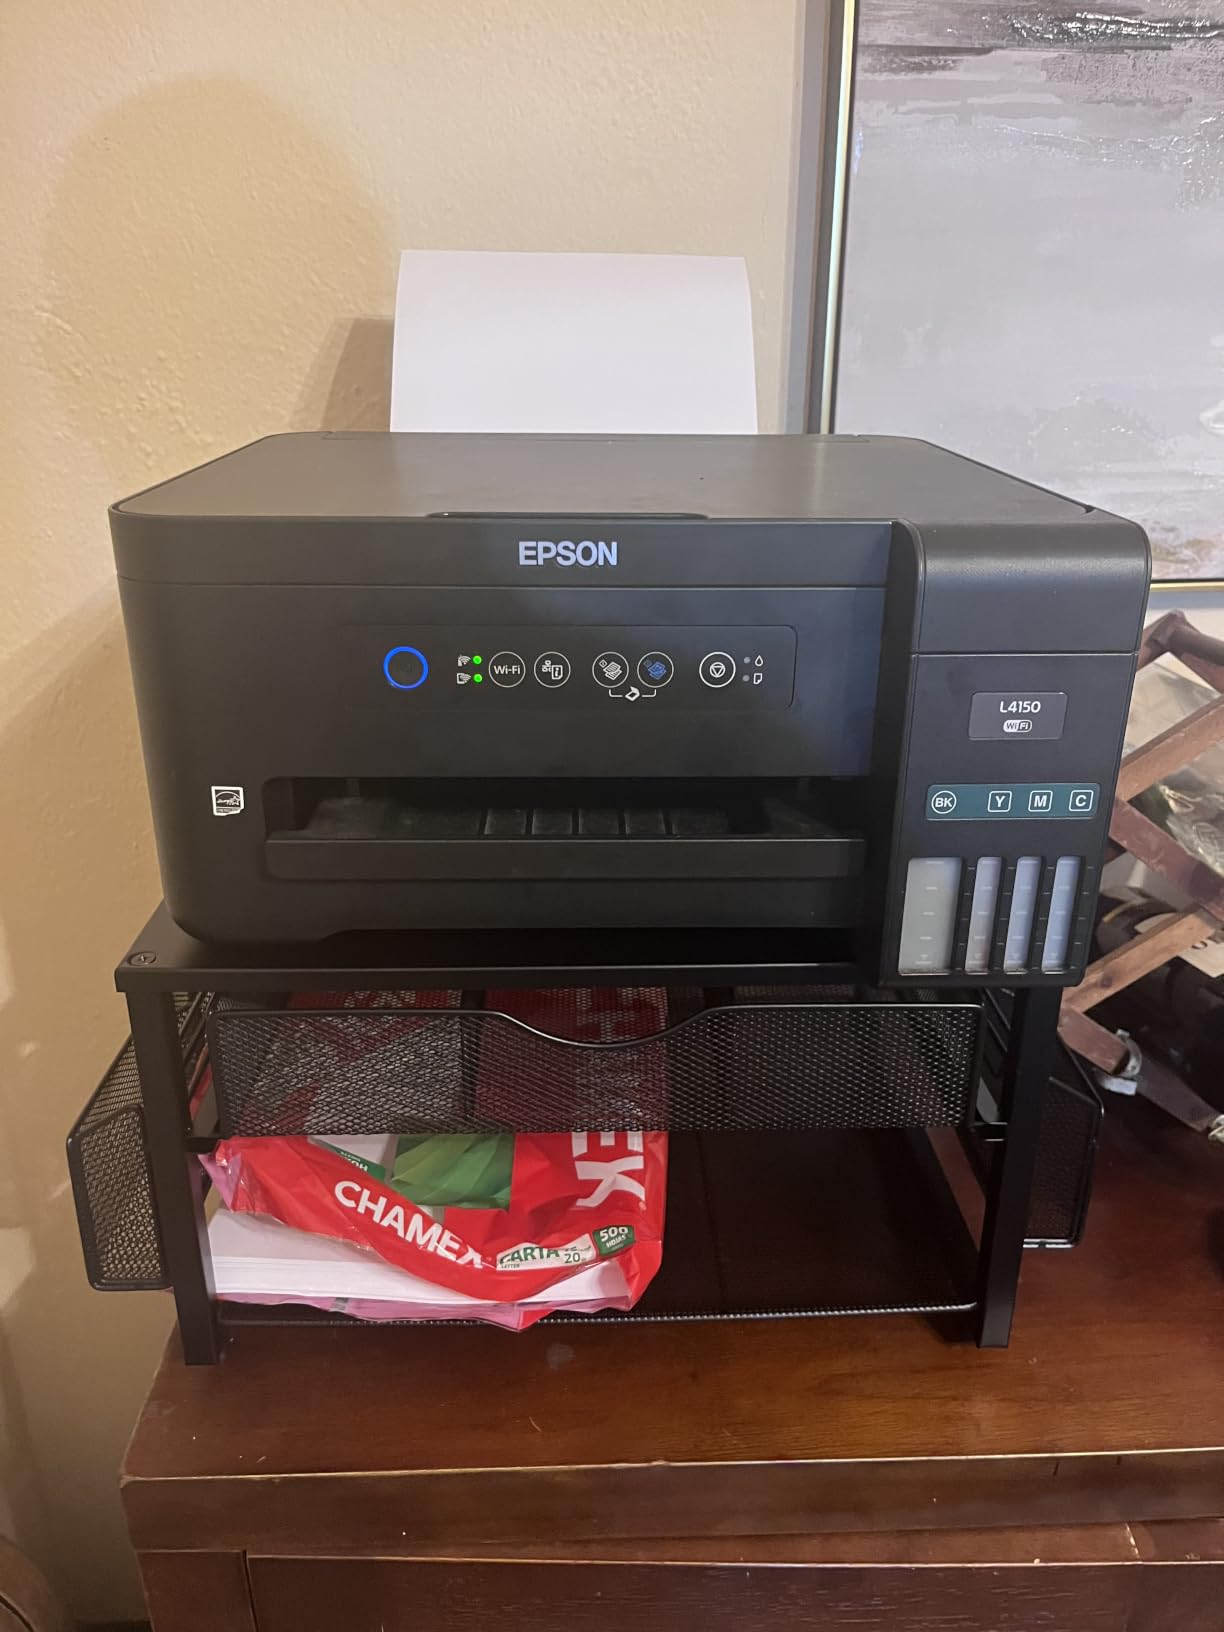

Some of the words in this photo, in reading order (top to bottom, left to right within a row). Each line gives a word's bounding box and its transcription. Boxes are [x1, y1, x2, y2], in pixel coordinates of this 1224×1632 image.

[518, 541, 618, 566] EPSON
[493, 664, 521, 675] Wi-Fi
[999, 700, 1041, 713] L4150
[934, 796, 953, 808] BK
[995, 796, 1005, 807] Y
[1033, 796, 1047, 807] M
[1076, 795, 1087, 806] C
[334, 1180, 483, 1269] CHAMEX
[599, 1226, 629, 1242] 500
[564, 1252, 581, 1264] 20
